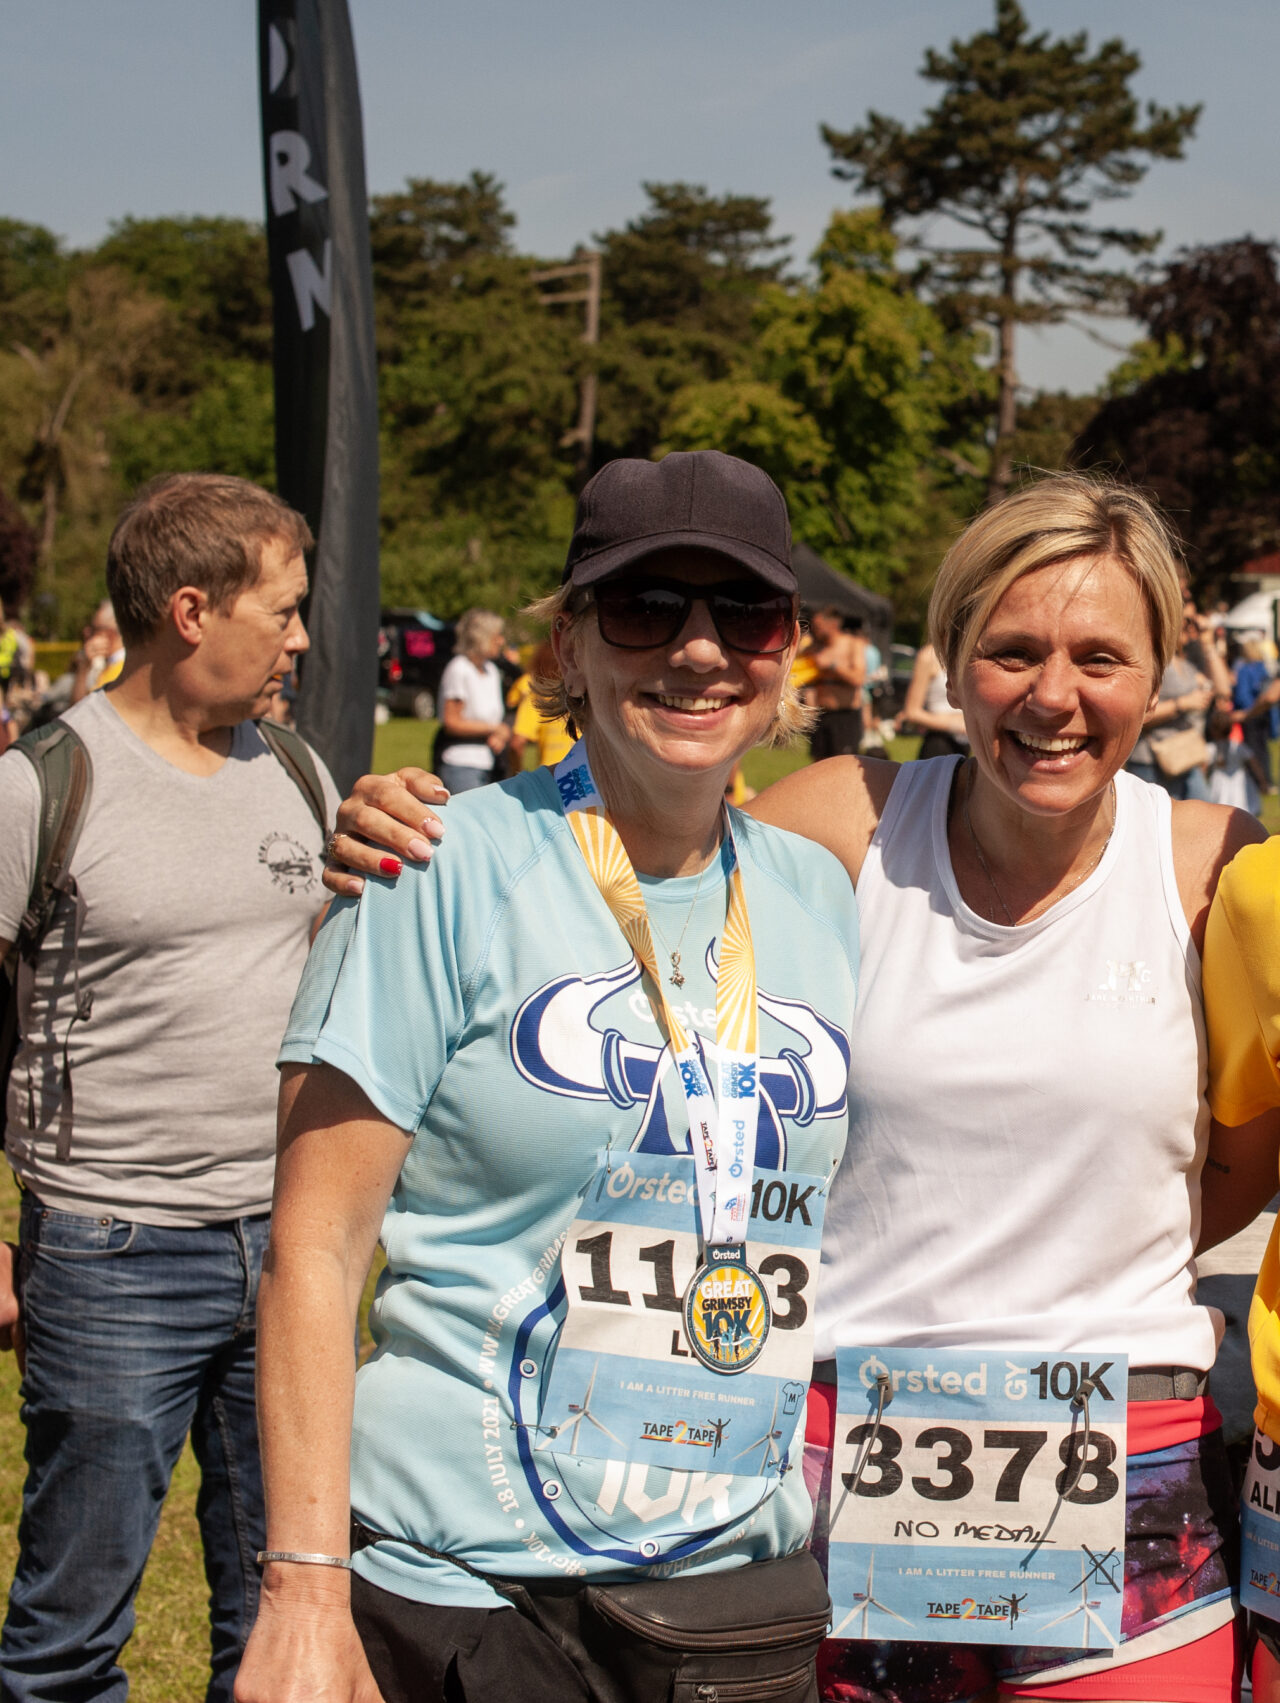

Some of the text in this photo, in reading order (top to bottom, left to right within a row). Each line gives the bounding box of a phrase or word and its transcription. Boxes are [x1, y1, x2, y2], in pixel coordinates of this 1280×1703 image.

[557, 771, 581, 808] 10K
[628, 988, 718, 1030] Øste
[679, 1060, 701, 1100] 10K
[730, 1060, 739, 1099] GRIMSBY
[737, 1061, 756, 1099] 10K
[750, 1178, 817, 1226] 10K
[575, 1230, 810, 1331] 113
[701, 1279, 752, 1299] GREAT
[701, 1296, 753, 1312] GRIMSBY
[702, 1309, 752, 1341] 10K
[627, 1381, 644, 1393] AM
[646, 1383, 654, 1393] A
[656, 1385, 690, 1398] LITTER
[692, 1391, 715, 1401] FREE
[718, 1393, 755, 1406] RUNNER
[788, 1393, 797, 1403] M
[1004, 1360, 1028, 1401] GY
[1030, 1361, 1115, 1401] 10K
[482, 1396, 520, 1513] 18 JULY 2021
[841, 1422, 1120, 1505] 3378
[893, 1519, 1057, 1544] NO MEDAL
[1258, 1536, 1280, 1552] LITTER
[905, 1568, 923, 1576] AM
[926, 1568, 934, 1576] A
[936, 1568, 975, 1578] LITTER
[978, 1569, 1006, 1579] FREE
[1009, 1570, 1056, 1580] RUNNER
